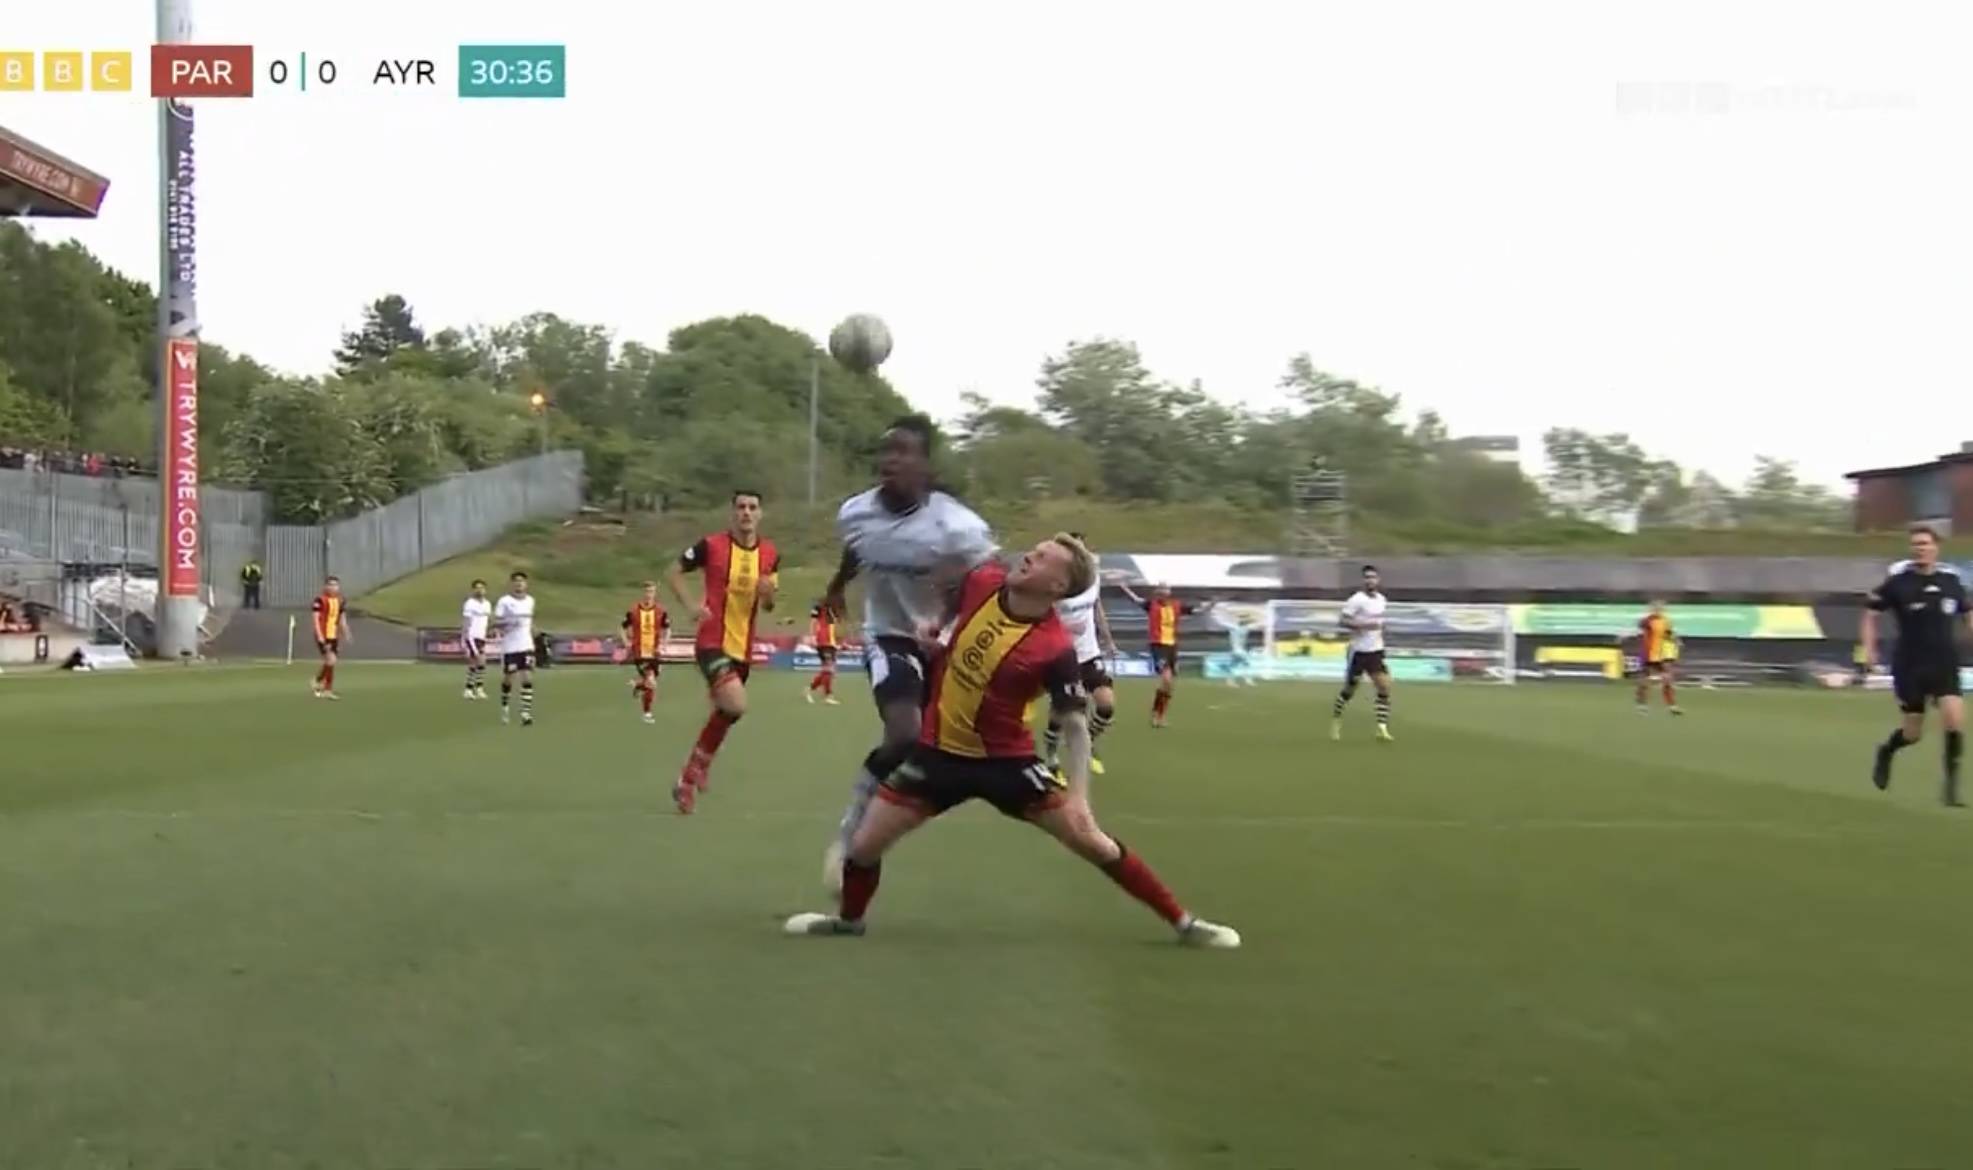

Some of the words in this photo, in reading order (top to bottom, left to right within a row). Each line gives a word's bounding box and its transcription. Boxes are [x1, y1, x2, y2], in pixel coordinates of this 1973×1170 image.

[178, 185, 193, 246] TRADES
[179, 253, 193, 283] LTD
[177, 380, 198, 569] TRYWYRE.COM
